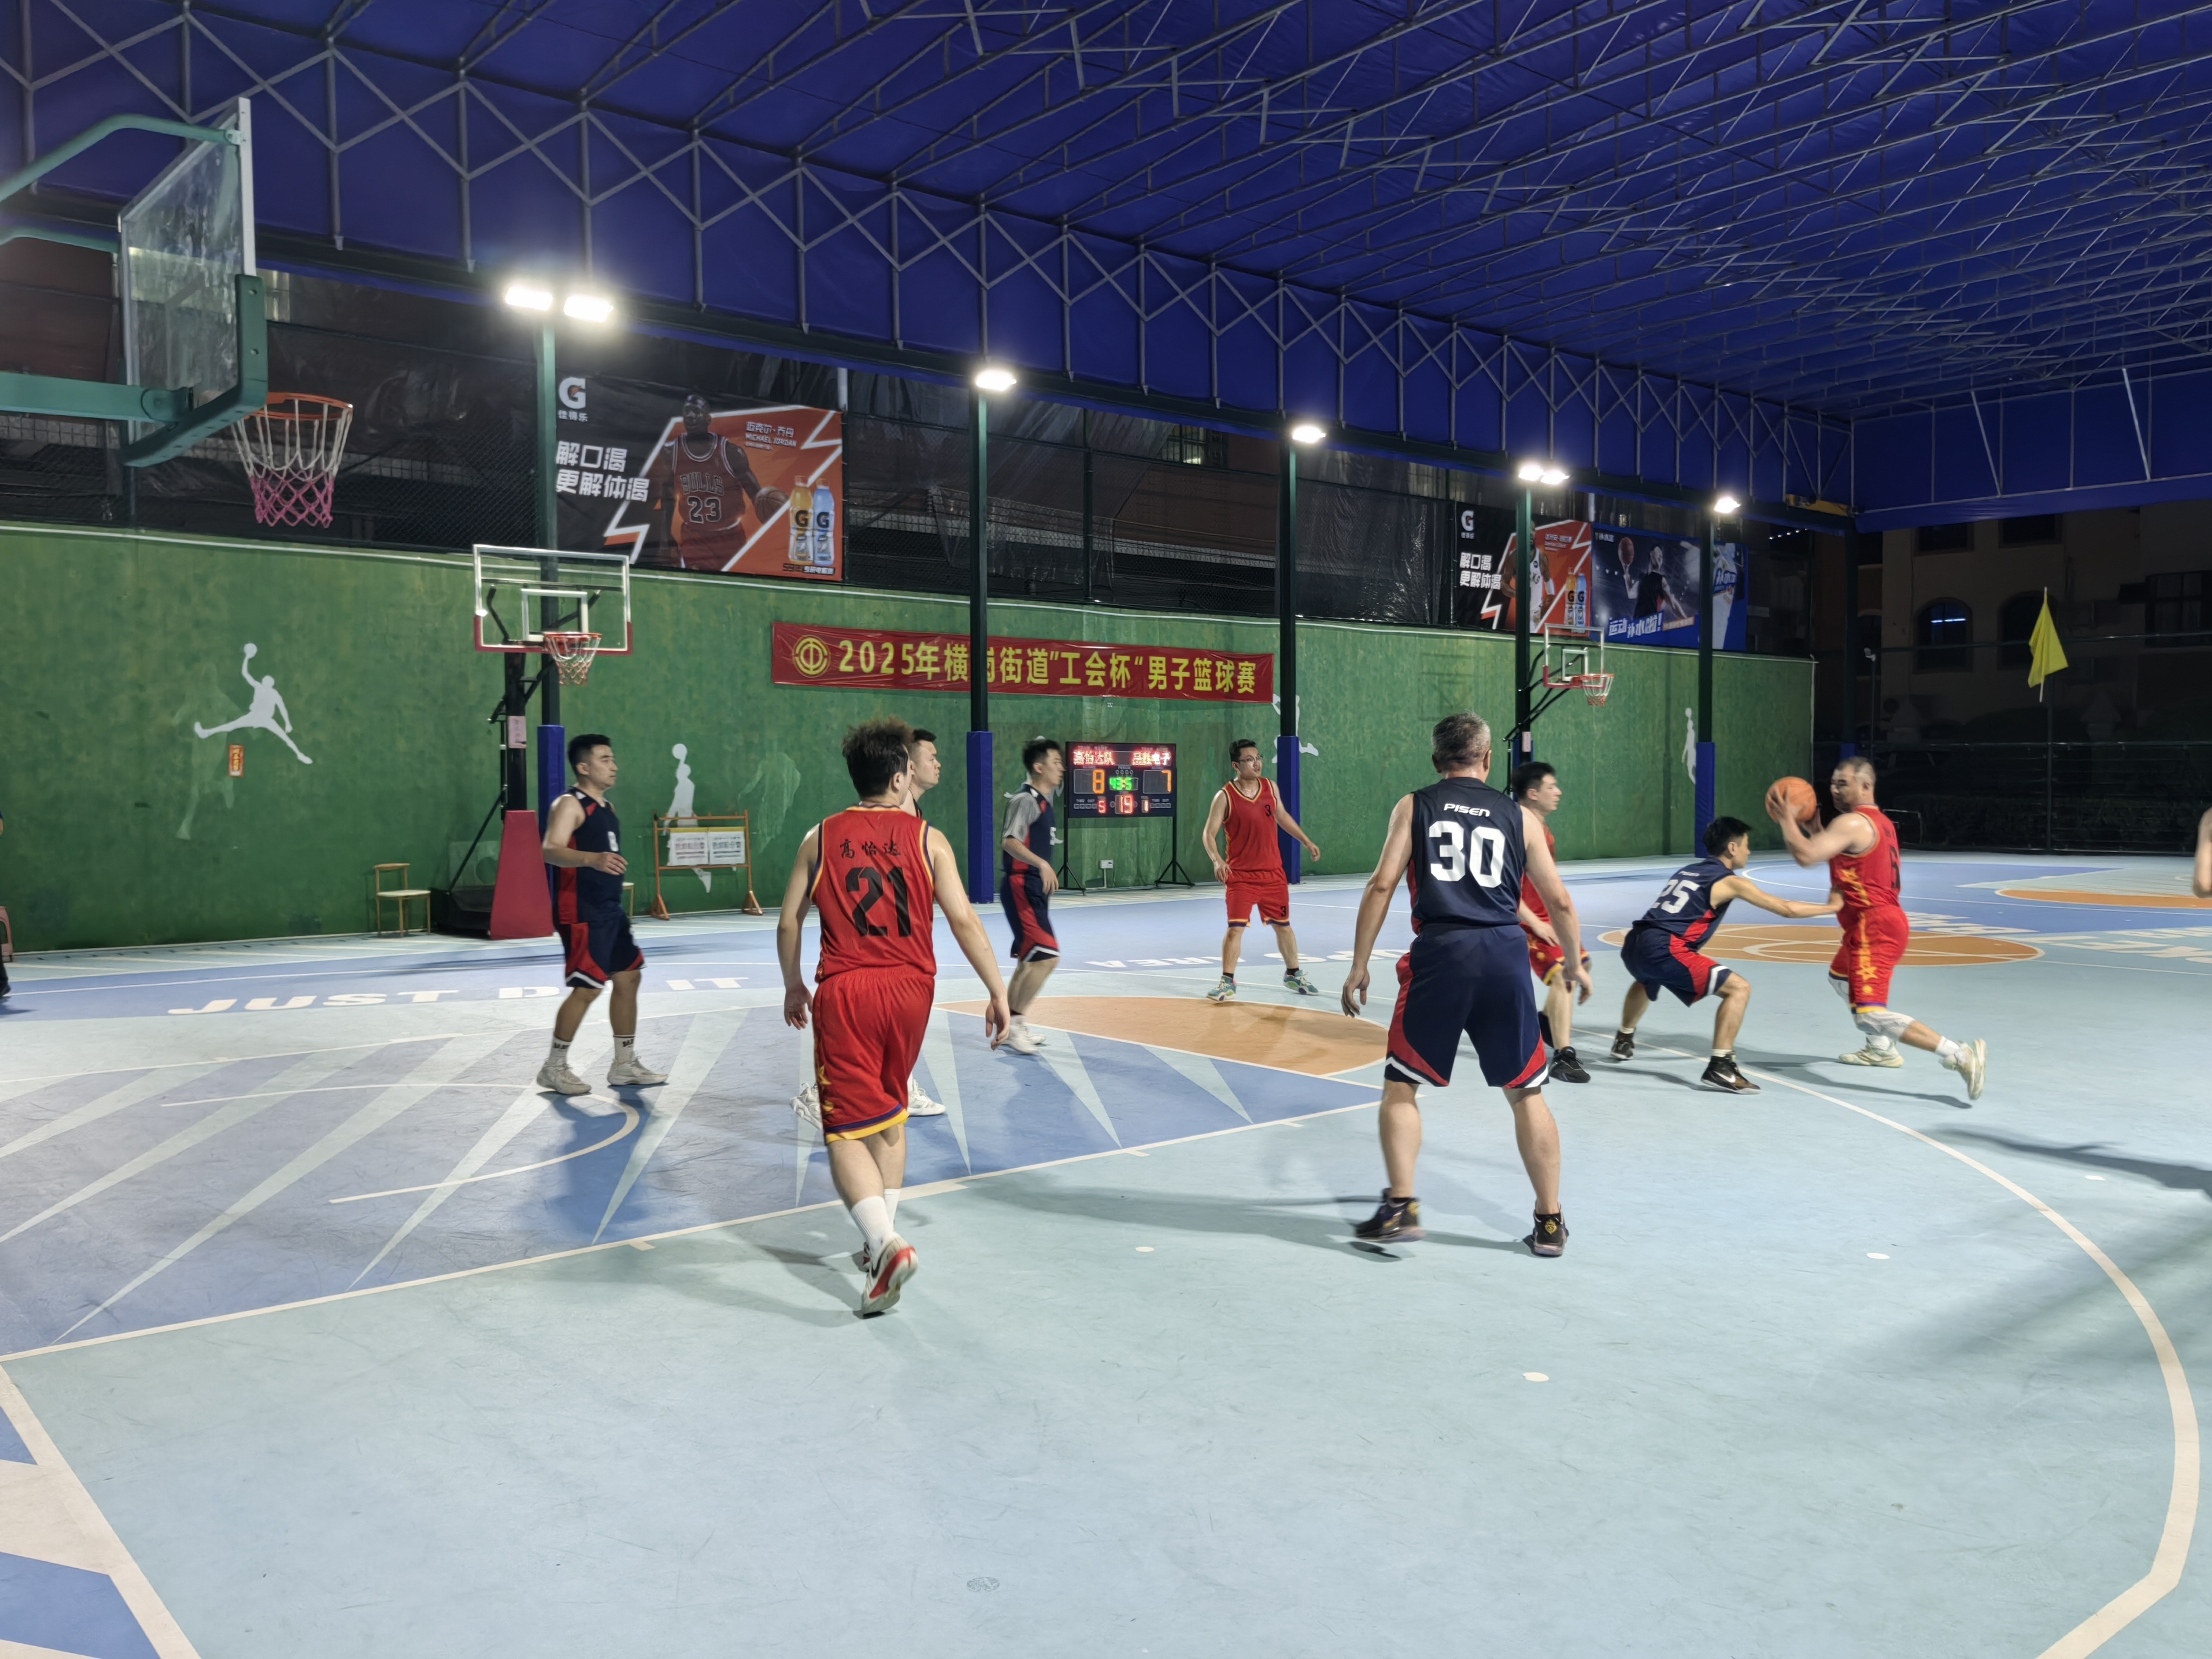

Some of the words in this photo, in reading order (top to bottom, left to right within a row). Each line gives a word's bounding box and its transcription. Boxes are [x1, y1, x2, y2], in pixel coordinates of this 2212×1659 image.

[559, 377, 586, 409] G
[558, 410, 588, 422] 佳得乐
[556, 441, 627, 472] 解口渴
[556, 469, 650, 502] 更解体渴
[680, 473, 724, 496] BULLS
[687, 496, 721, 524] 23
[795, 510, 808, 527] G
[817, 512, 829, 528] G
[1461, 510, 1474, 531] G
[1460, 552, 1492, 571] 解口渴
[1092, 769, 1105, 794] 8
[1162, 770, 1171, 792] 7
[1120, 794, 1133, 813] 19
[1265, 804, 1272, 817] 3
[1444, 803, 1491, 817] PISEN
[1429, 820, 1505, 888] 30
[845, 867, 911, 937] 21
[1652, 879, 1700, 914] 25
[167, 990, 459, 1014] JUST
[666, 976, 749, 990] IT
